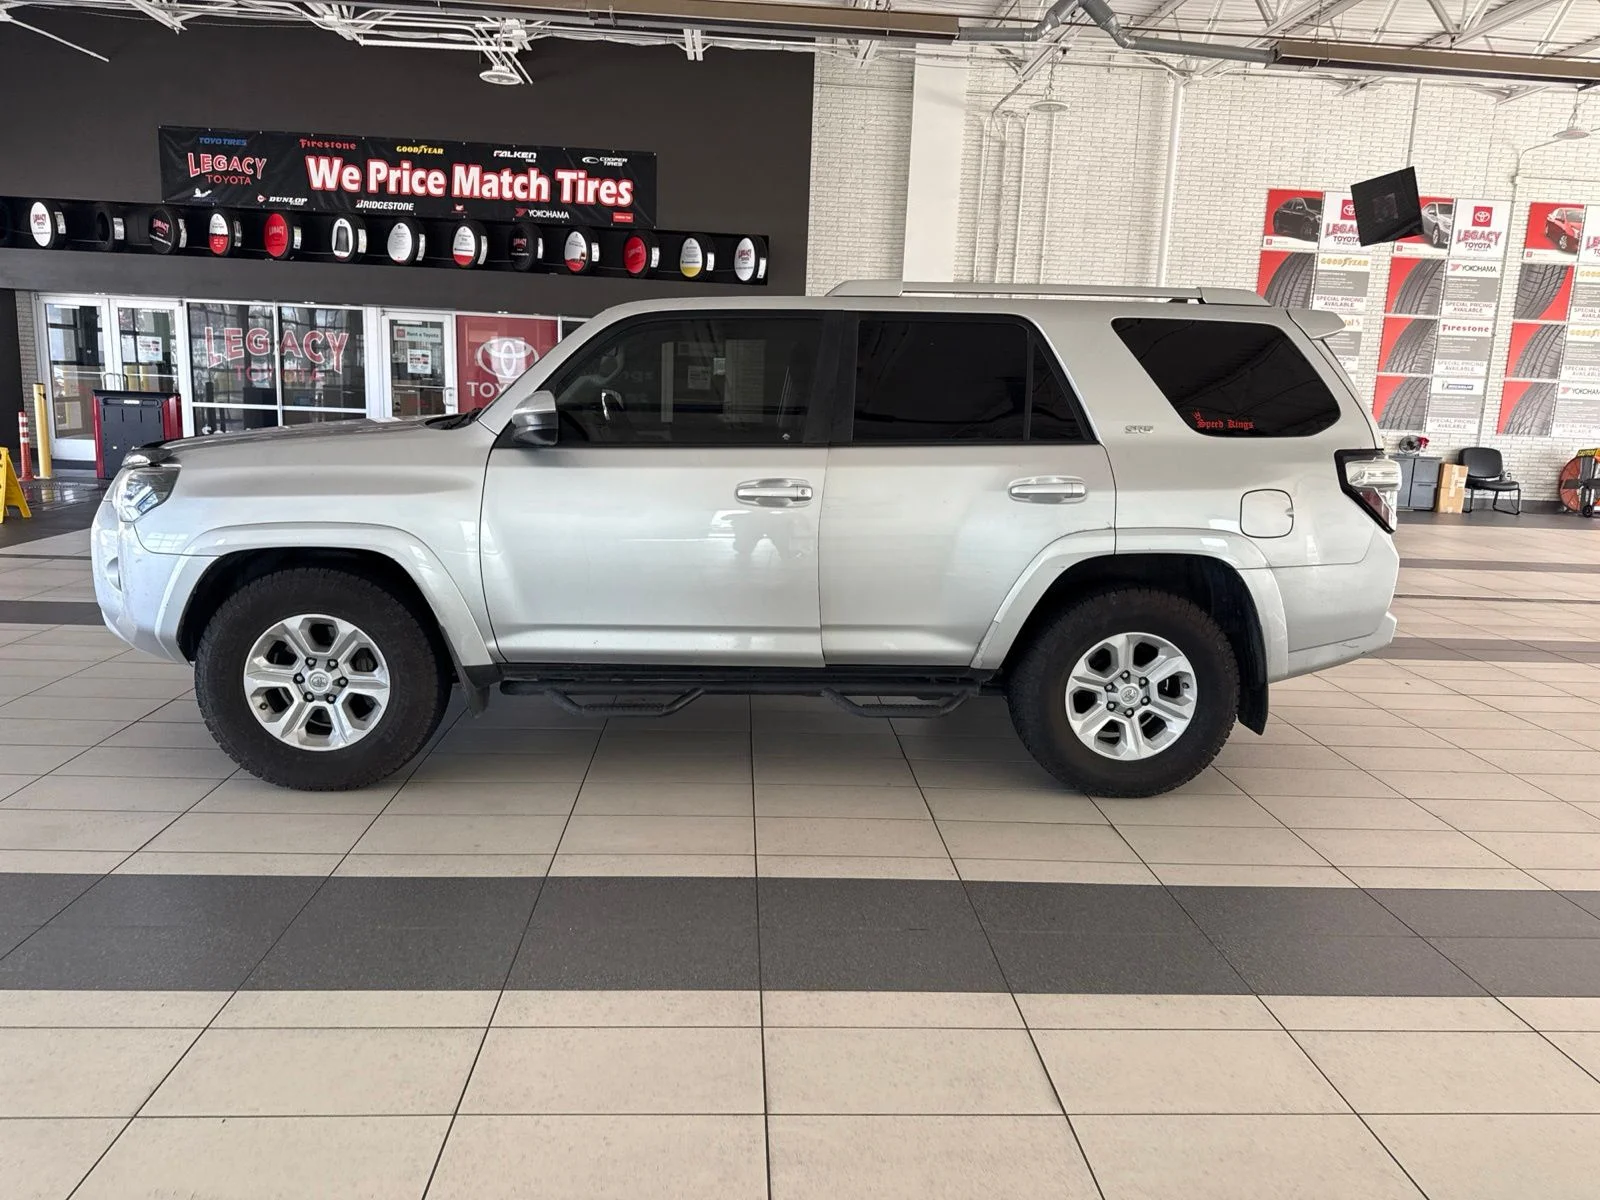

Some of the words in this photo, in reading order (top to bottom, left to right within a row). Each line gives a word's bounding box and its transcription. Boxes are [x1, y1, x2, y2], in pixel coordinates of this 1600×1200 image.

[199, 137, 222, 145] TOYO
[299, 138, 357, 150] Firestone
[396, 145, 444, 155] GOODYEAR
[493, 150, 537, 159] FALKEN
[187, 152, 267, 180] LEGACY
[205, 174, 252, 185] TOYOTA
[305, 155, 362, 193] We
[366, 158, 448, 197] Price
[452, 163, 550, 202] Match
[554, 168, 634, 207] Tires
[355, 200, 415, 211] BRIDGESTONE
[528, 209, 570, 219] YOKOHAMA
[1325, 222, 1358, 238] LEGA
[1456, 229, 1502, 246] LEGACY
[1465, 241, 1491, 249] TOYOTA
[1320, 257, 1369, 267] GOODYEAR
[1461, 264, 1497, 272] YOKOHAMA
[1441, 323, 1490, 332] Firestone
[204, 326, 349, 375] LEGACY
[466, 381, 507, 398] TOY
[1196, 418, 1224, 430] Speed
[1226, 418, 1255, 431] Kings
